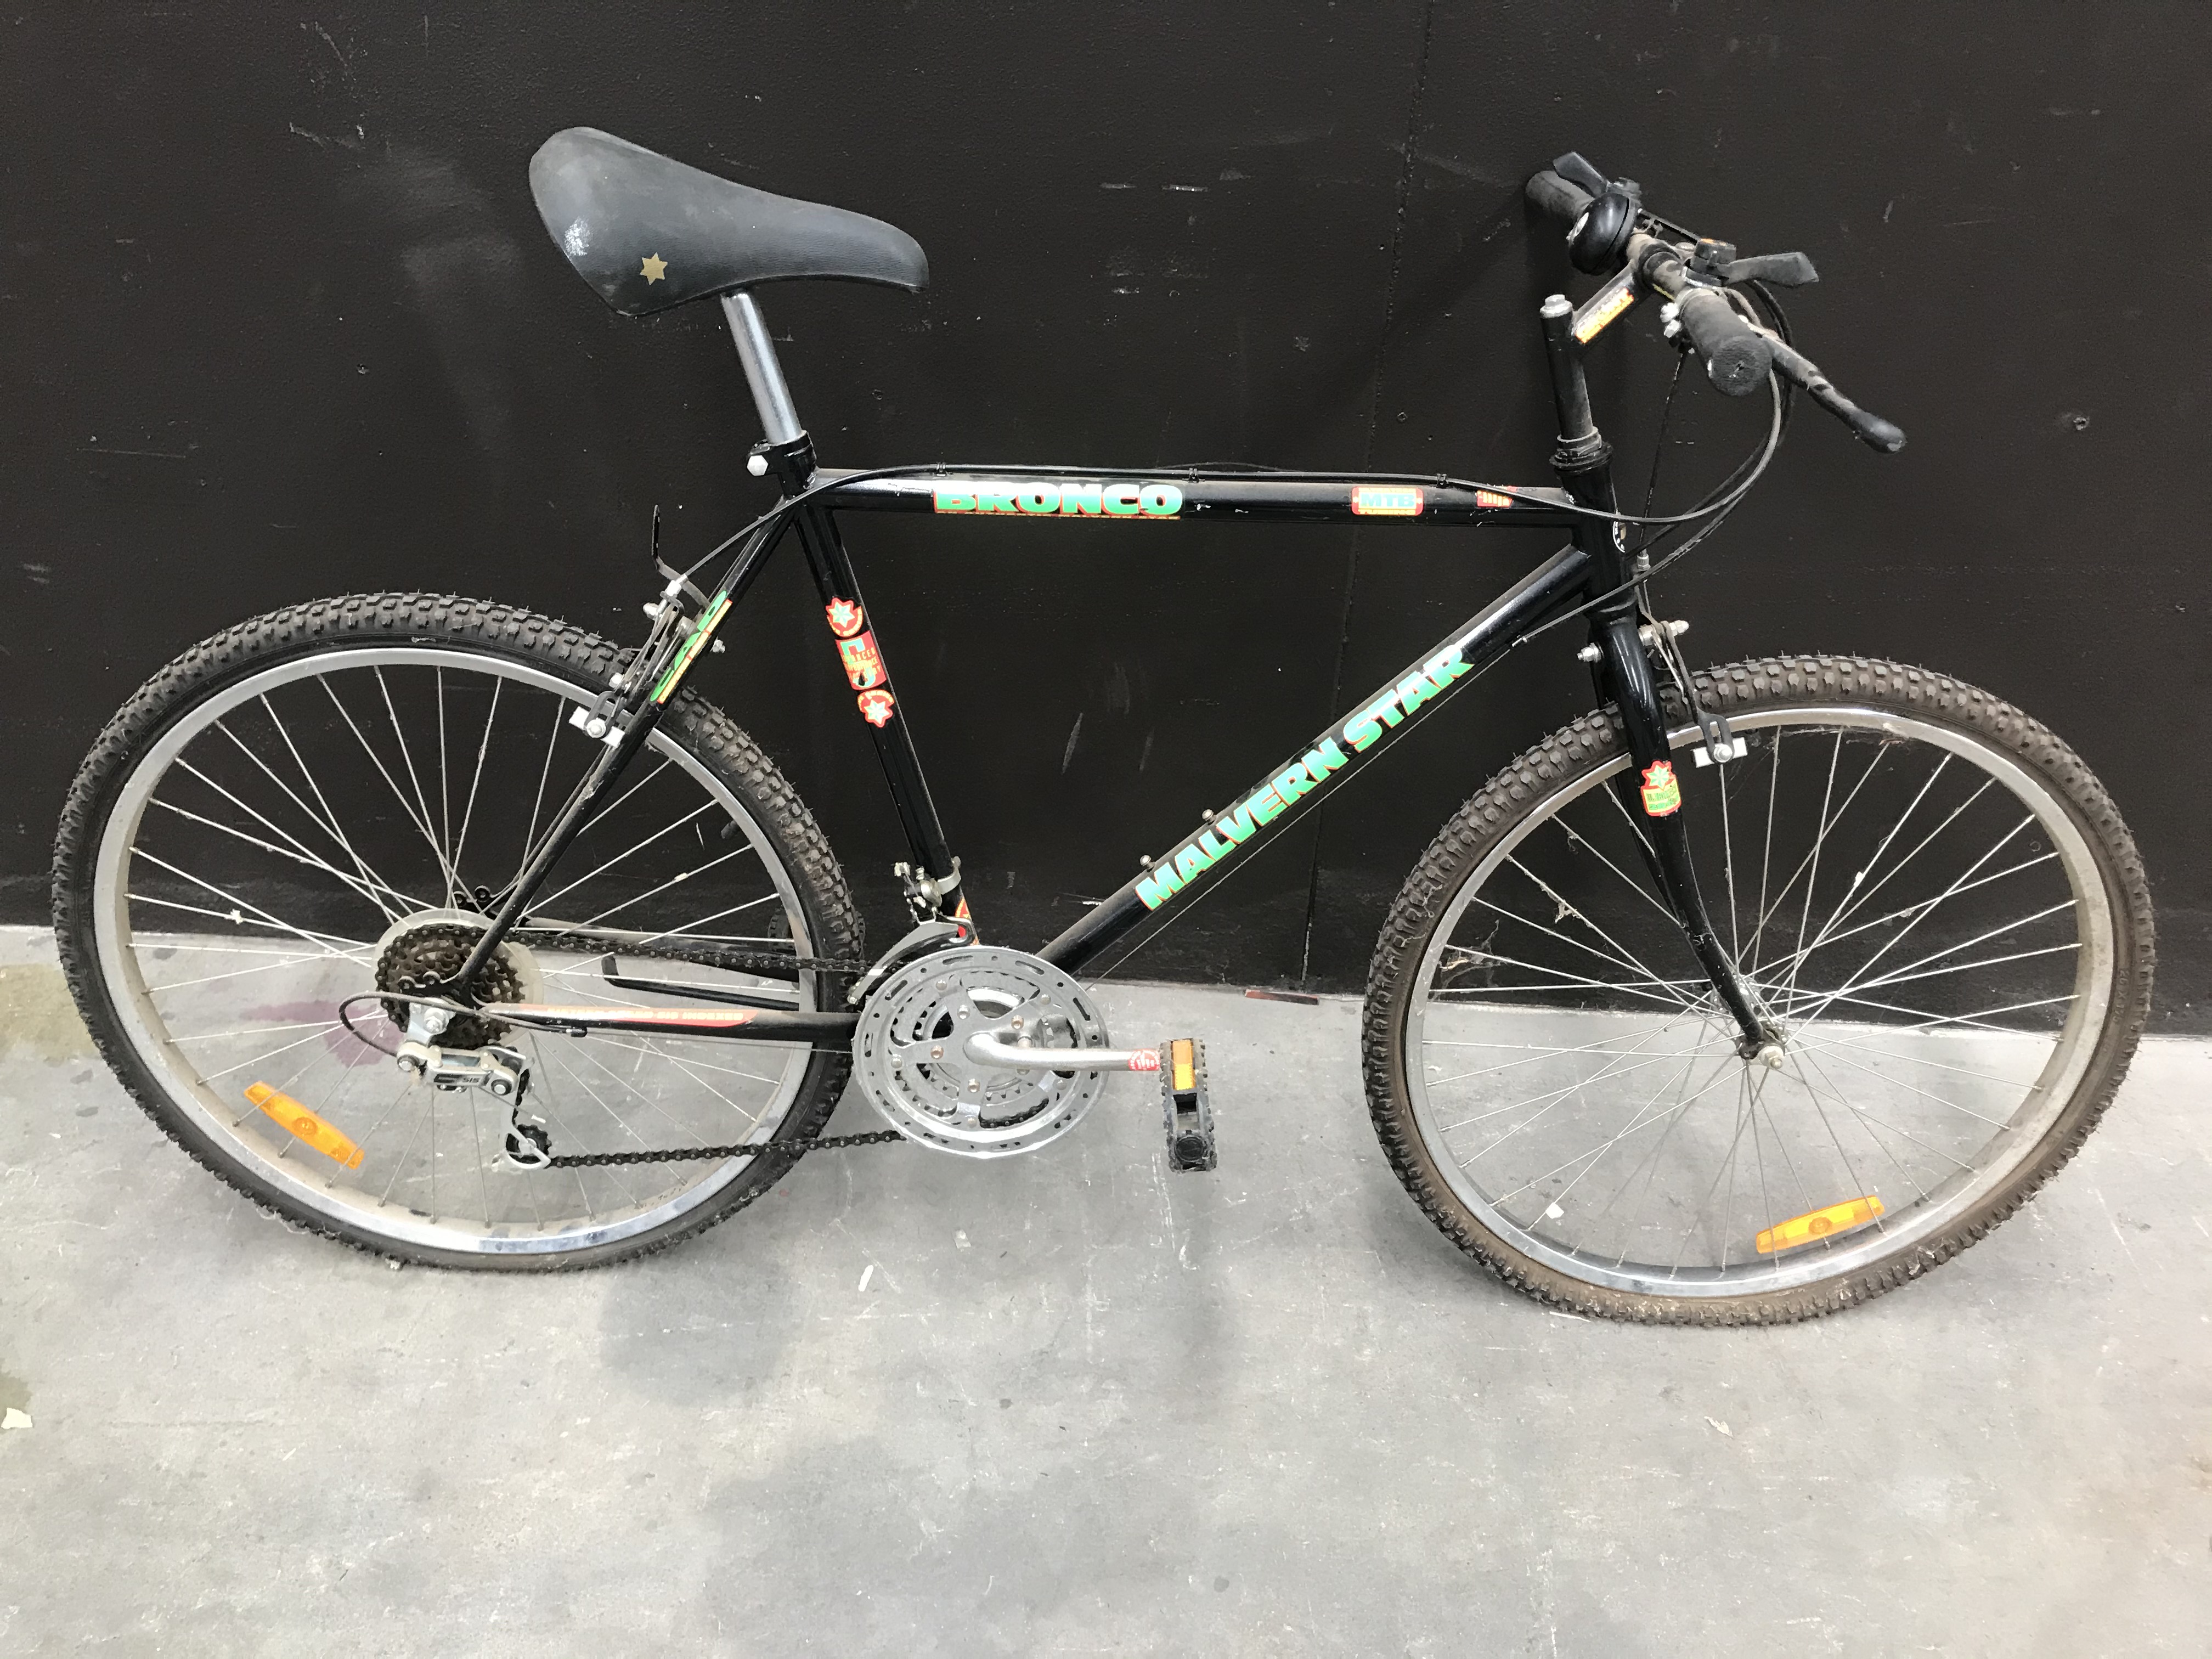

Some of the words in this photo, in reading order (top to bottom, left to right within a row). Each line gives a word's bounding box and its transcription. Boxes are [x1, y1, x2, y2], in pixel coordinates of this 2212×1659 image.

[934, 481, 1183, 516] BRONCO
[1361, 492, 1415, 507] MTB
[1135, 736, 1348, 911] MALVERN
[1343, 644, 1474, 753] STAR
